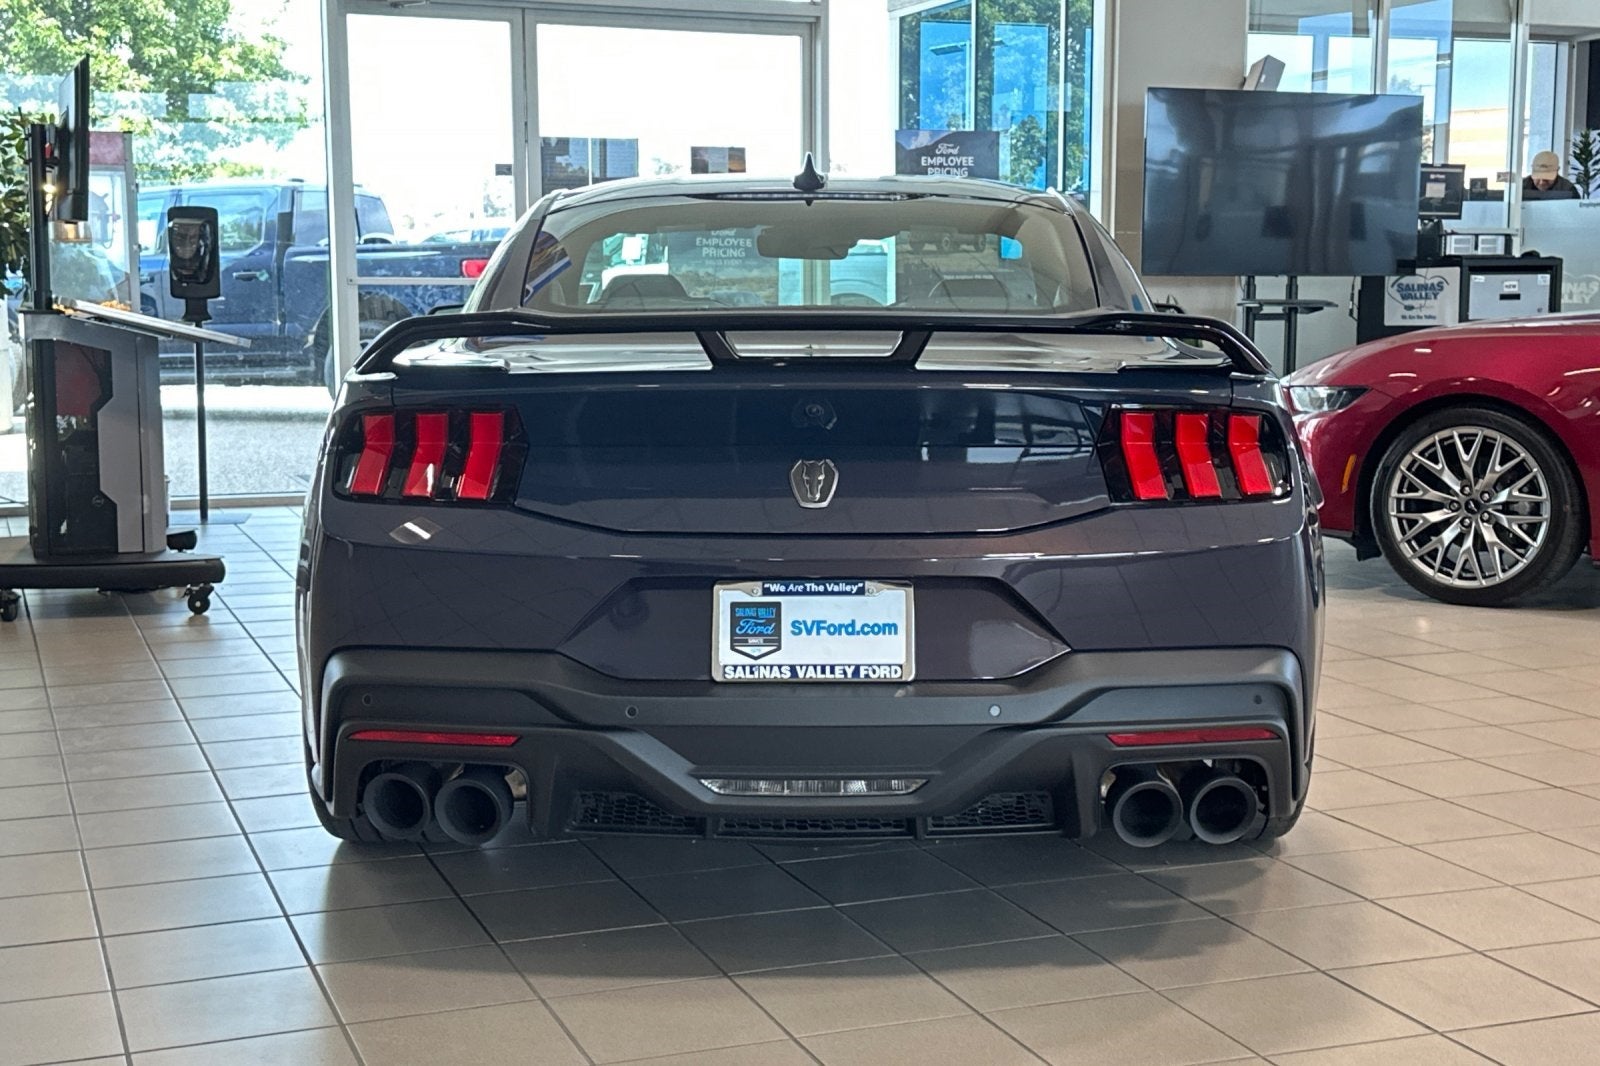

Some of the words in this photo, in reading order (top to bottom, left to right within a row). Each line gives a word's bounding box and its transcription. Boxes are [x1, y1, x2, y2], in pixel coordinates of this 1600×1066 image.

[935, 142, 960, 155] Ford
[921, 156, 974, 166] EMPLOYEE
[927, 167, 969, 177] PRICING
[695, 237, 752, 248] EMPLOYEE
[702, 247, 746, 258] PRICING
[1396, 280, 1445, 293] SALINAS
[1400, 291, 1440, 301] VALLEY
[787, 584, 804, 593] Are
[805, 583, 824, 593] The
[735, 618, 776, 635] Ford
[790, 619, 898, 637] SVFord.com
[724, 665, 791, 679] SALINAS
[797, 665, 854, 679] VALLEY
[860, 665, 902, 679] FORD
